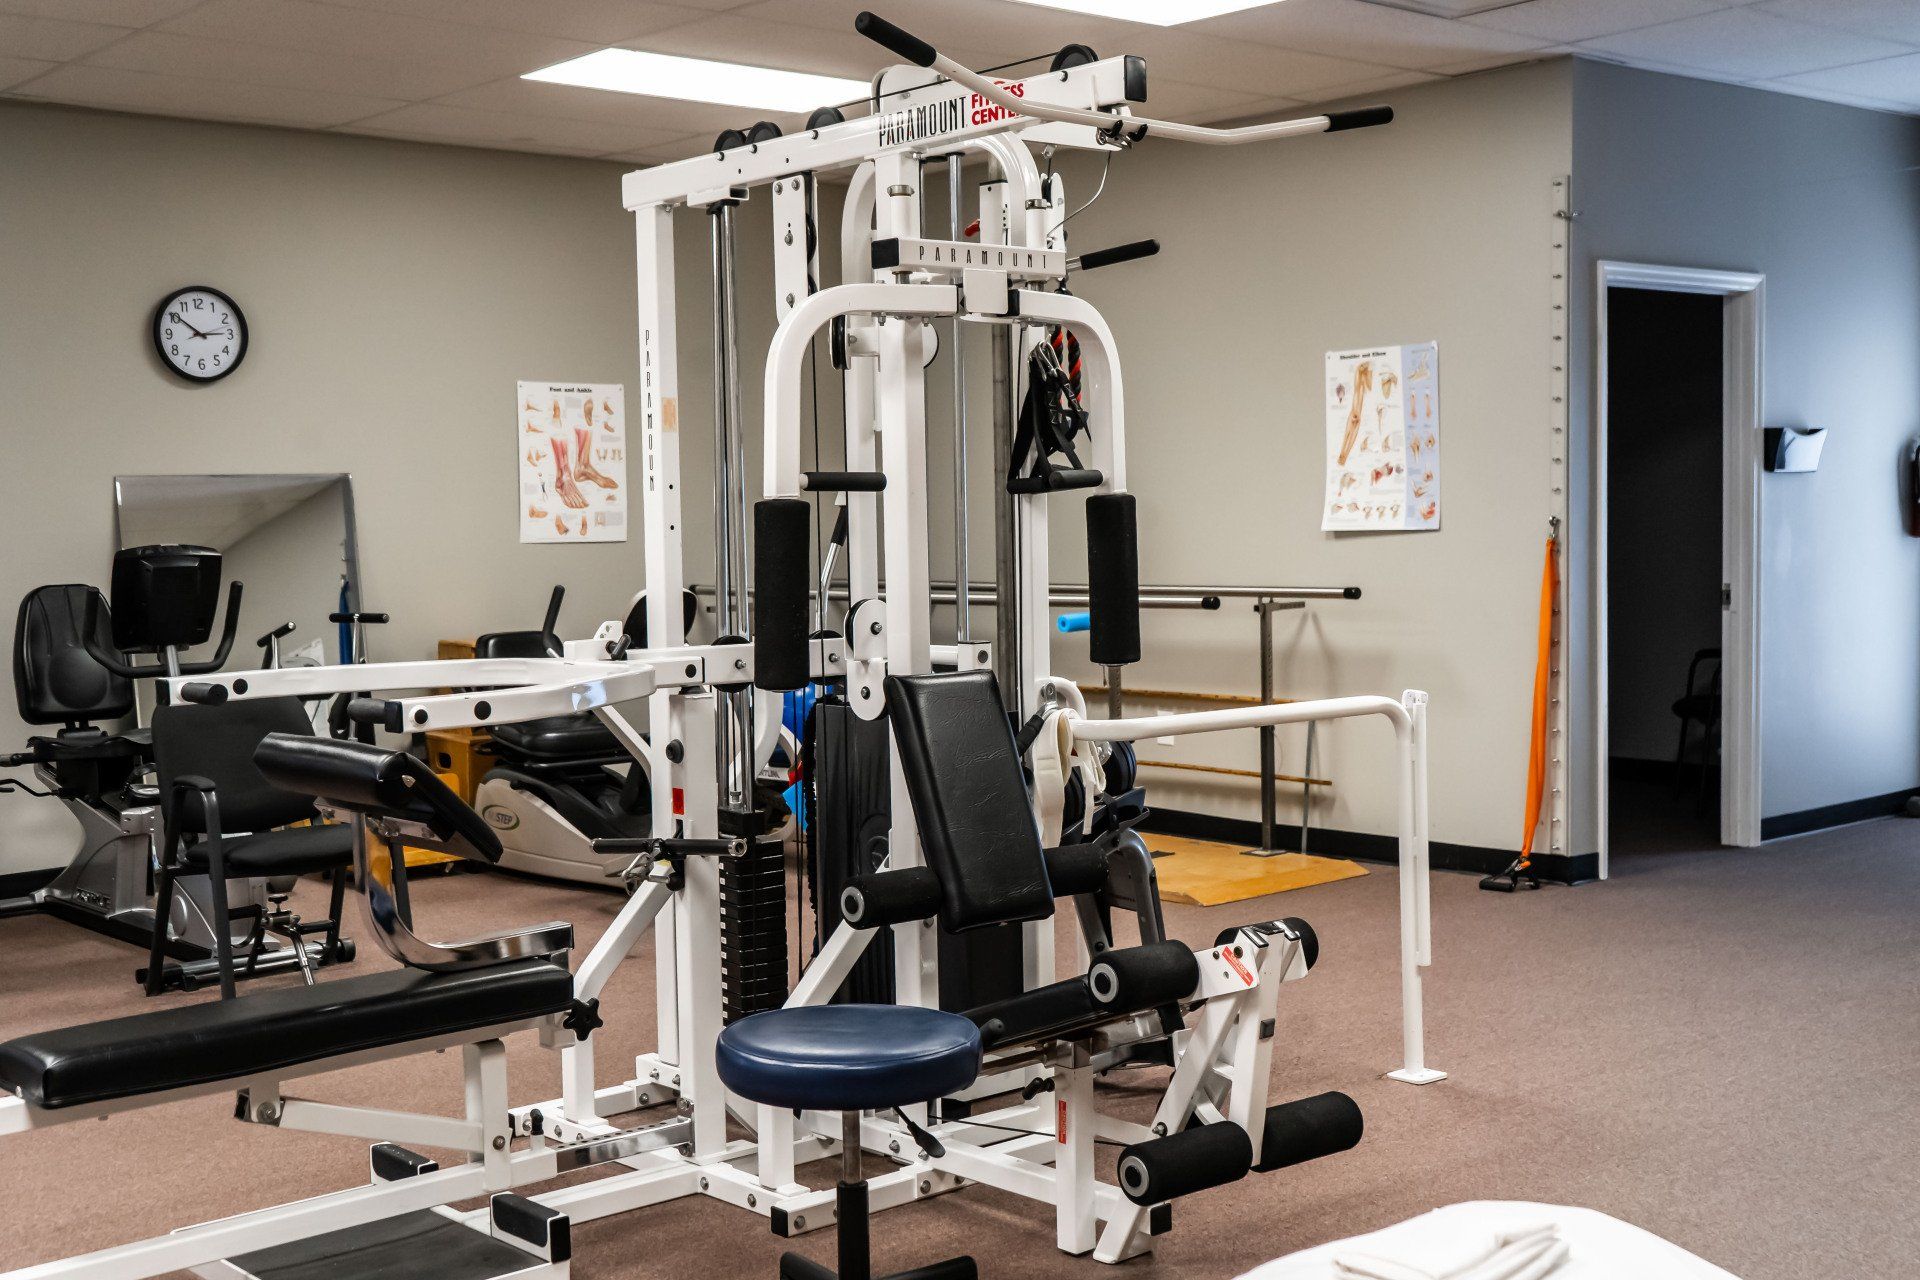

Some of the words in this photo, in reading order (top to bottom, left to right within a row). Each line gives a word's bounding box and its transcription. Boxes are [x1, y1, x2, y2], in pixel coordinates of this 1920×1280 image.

[879, 96, 967, 147] PARAMOUNT
[919, 245, 1047, 269] PARAMOUNT
[180, 301, 188, 313] 11
[193, 299, 203, 310] 12
[169, 312, 180, 324] 10
[221, 313, 229, 324] 2
[165, 328, 173, 340] 9
[226, 328, 234, 340] 3
[171, 344, 179, 356] 8
[221, 345, 230, 356] 4
[183, 355, 190, 366] 7
[198, 358, 206, 370] 6
[213, 354, 220, 366] 5
